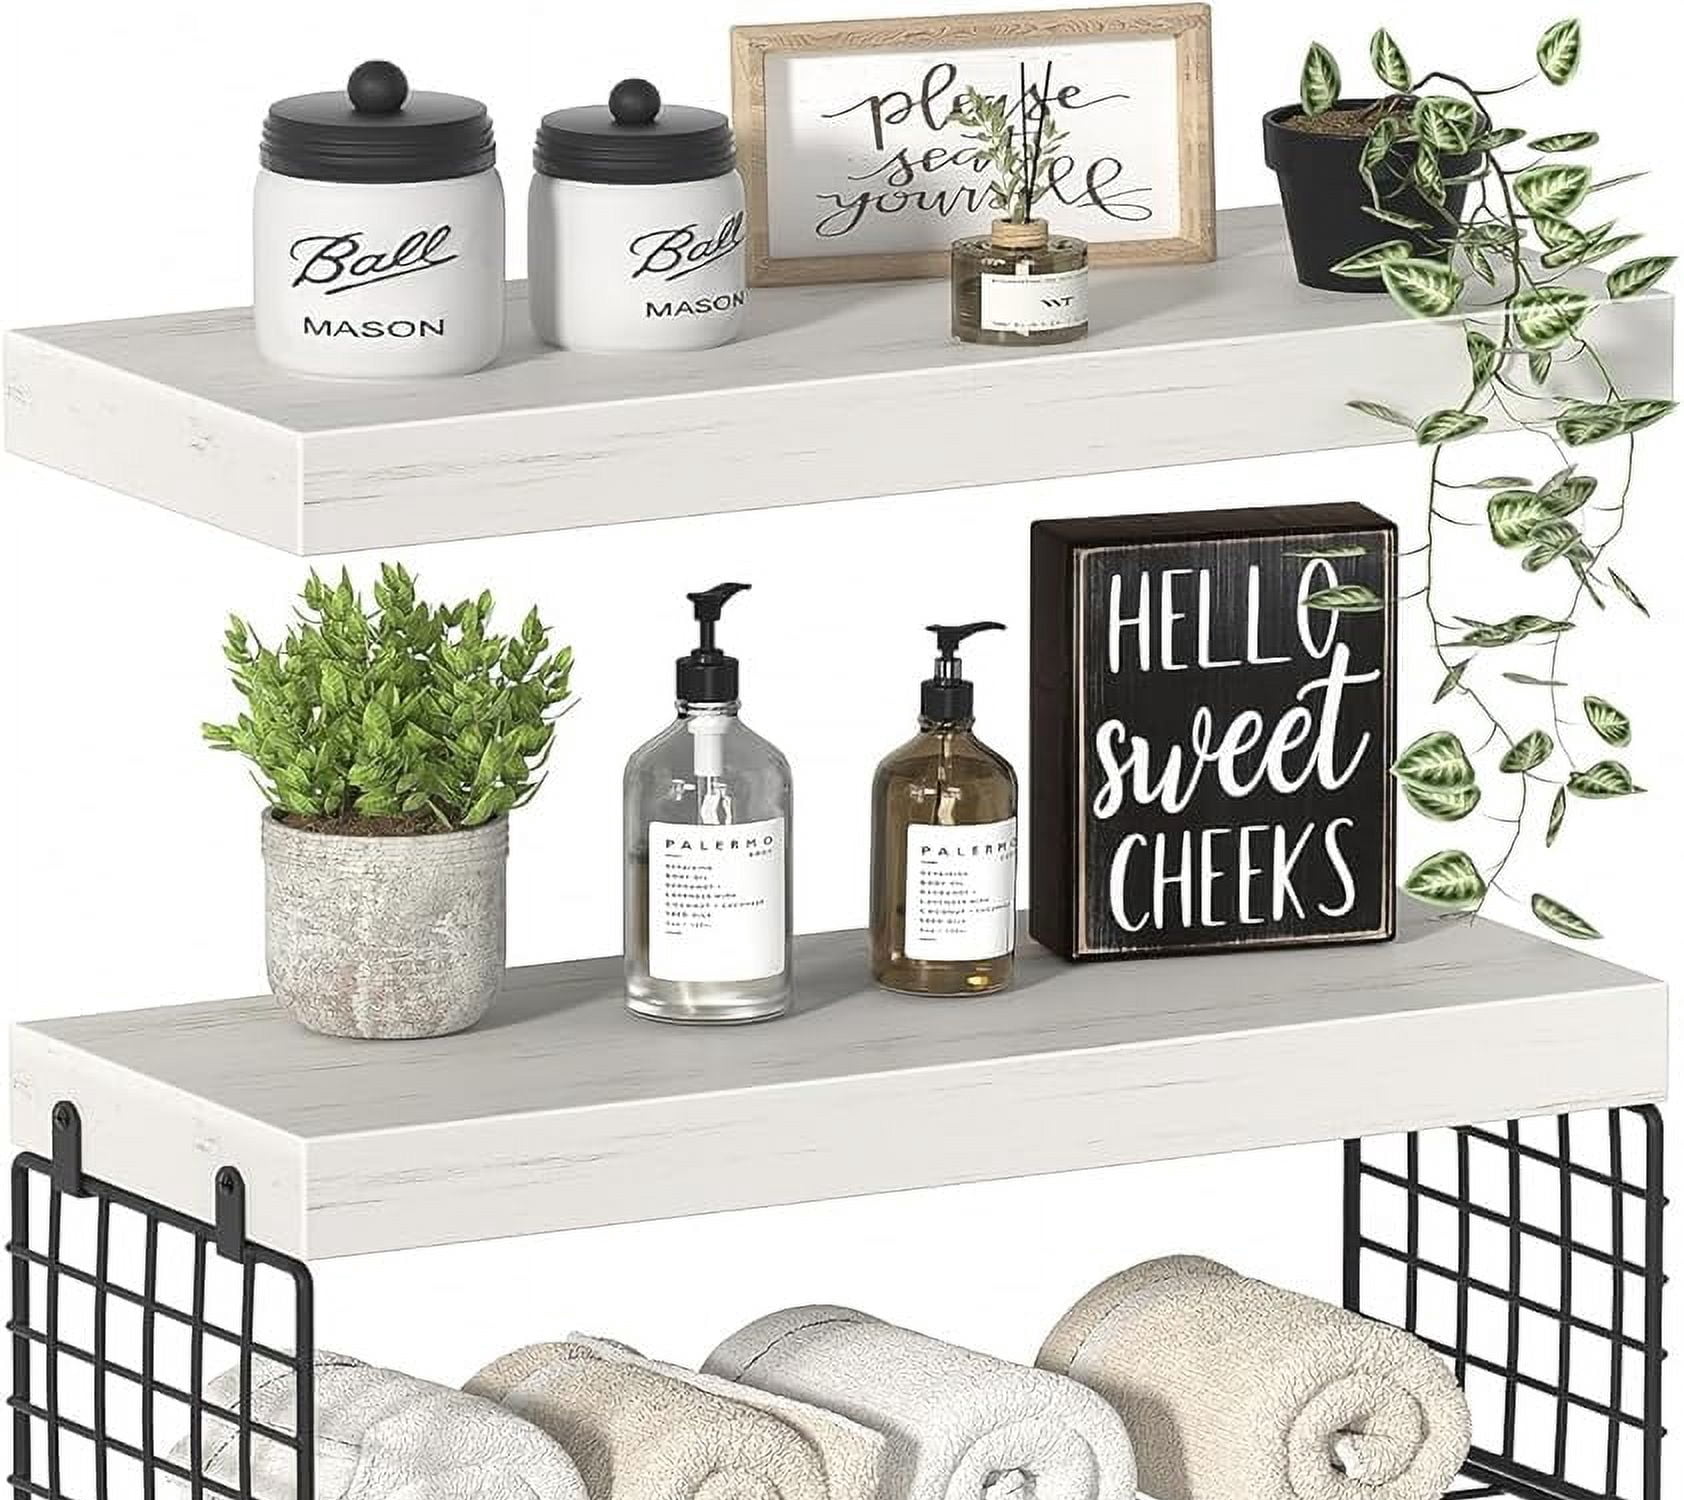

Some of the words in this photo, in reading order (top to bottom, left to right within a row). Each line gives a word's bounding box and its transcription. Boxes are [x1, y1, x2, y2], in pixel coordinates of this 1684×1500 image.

[289, 224, 460, 296] Ball
[629, 210, 745, 282] Ball
[303, 316, 445, 339] MASON
[645, 290, 746, 318] MASON
[1108, 557, 1340, 674] HELLO
[1093, 642, 1381, 819] sweet
[665, 835, 774, 851] PALERMO
[1109, 817, 1355, 932] CHEEKS
